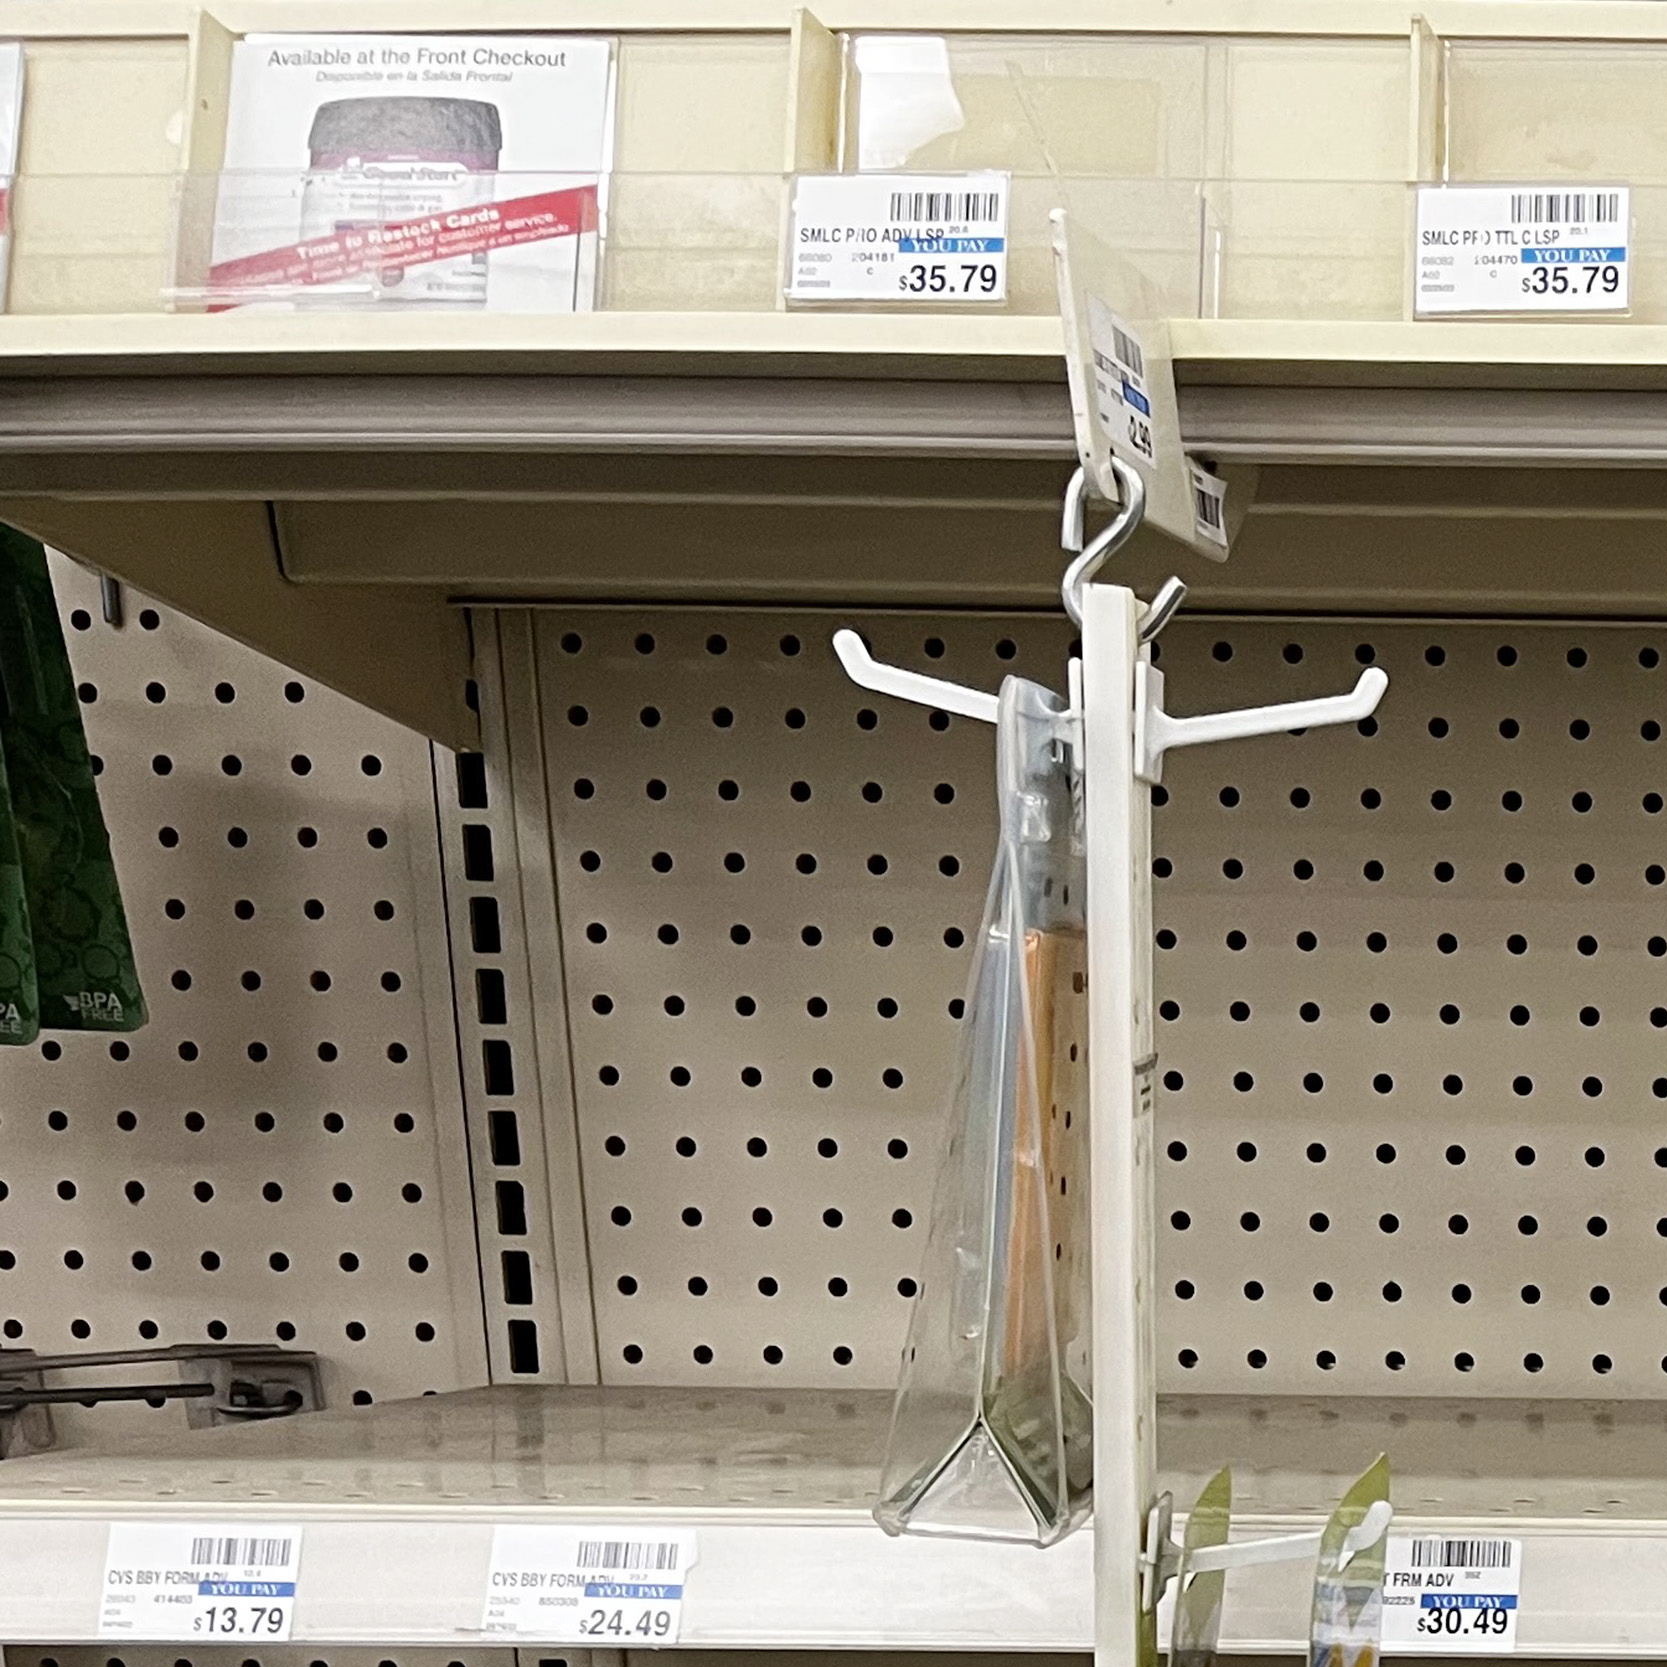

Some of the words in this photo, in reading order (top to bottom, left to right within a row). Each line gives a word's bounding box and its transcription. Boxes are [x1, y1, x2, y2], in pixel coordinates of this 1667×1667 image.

[268, 49, 351, 67] Available
[357, 51, 375, 65] at
[381, 49, 410, 65] the
[418, 49, 466, 66] Front
[473, 48, 566, 67] Checkout
[899, 264, 997, 292] $35.79
[1522, 266, 1618, 293] $35.79
[194, 1606, 284, 1635] $13.79
[580, 1610, 671, 1636] $24.49
[1418, 1607, 1508, 1635] $30.49
